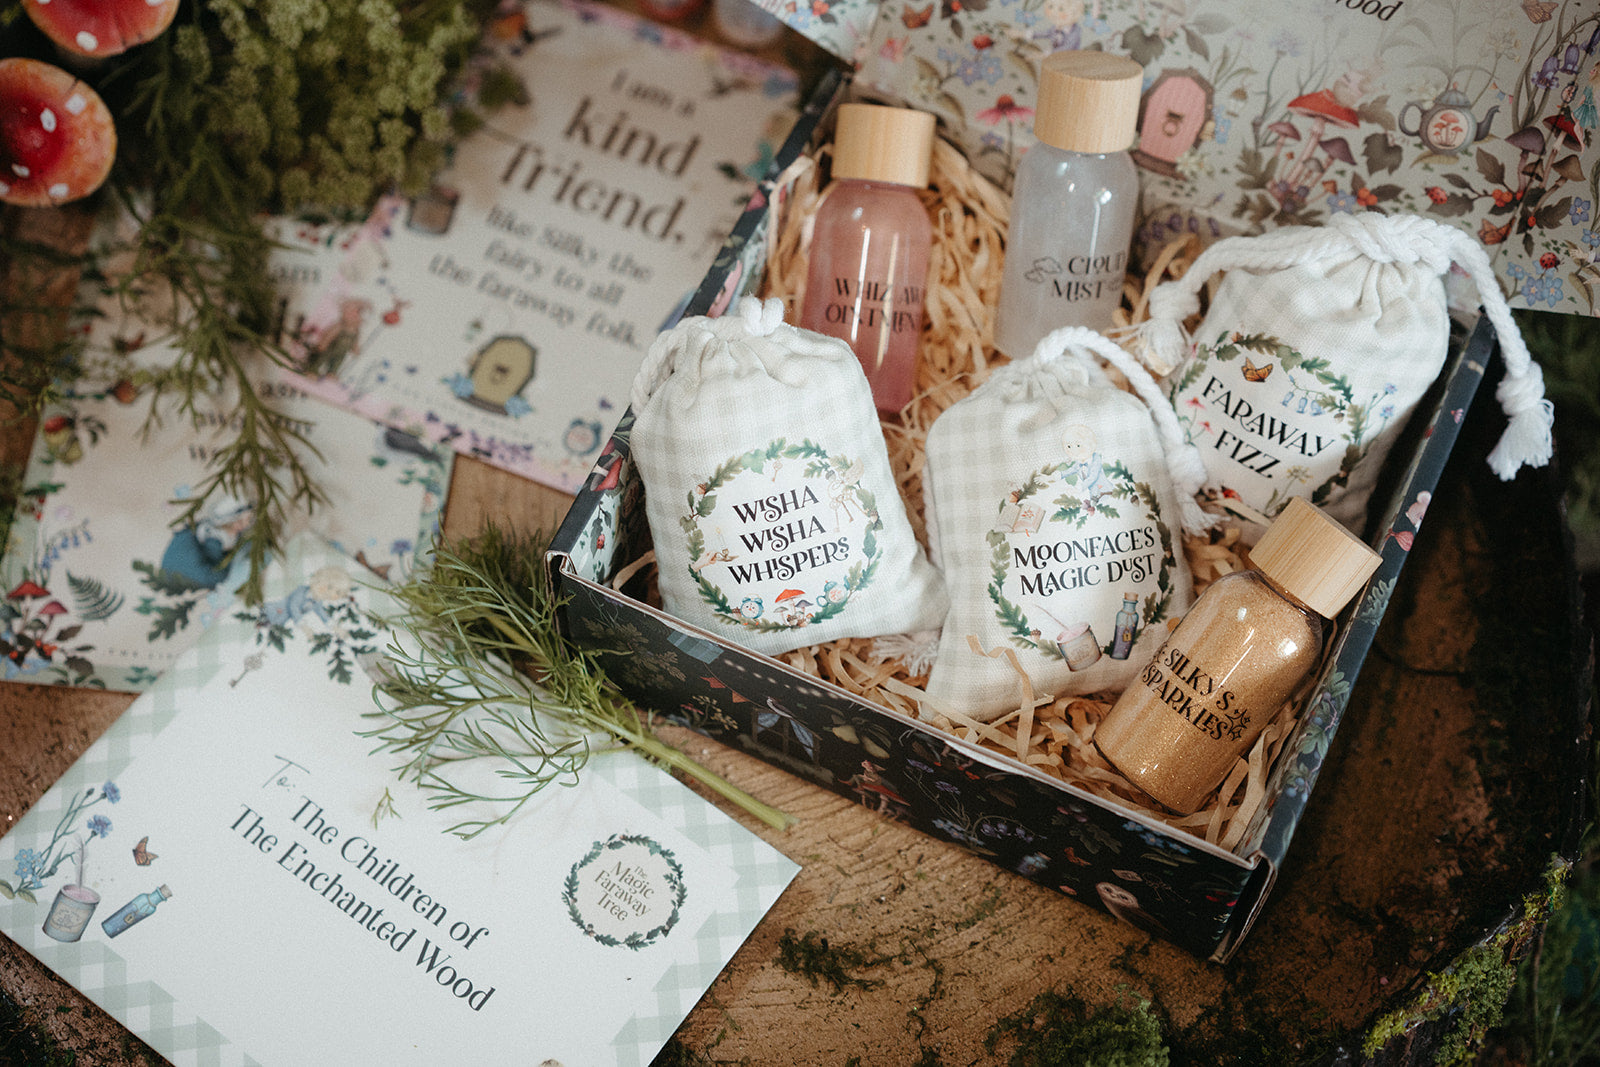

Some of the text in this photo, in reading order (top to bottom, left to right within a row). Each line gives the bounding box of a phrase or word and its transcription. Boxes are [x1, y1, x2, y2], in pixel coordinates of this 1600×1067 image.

[1336, 0, 1404, 21] ood
[565, 97, 702, 176] kind
[502, 143, 687, 242] friend.
[1051, 279, 1106, 302] MIST
[1202, 376, 1335, 457] FARAWAY
[1214, 430, 1281, 478] FIZZ
[732, 485, 820, 524] WISHA
[739, 516, 826, 553] WISHA
[1013, 526, 1155, 569] MOONFACE'S
[728, 537, 850, 584] WHISPERS
[1020, 553, 1155, 597] MAGIC DUST
[1142, 665, 1228, 740] SPARKLES
[290, 795, 490, 951] The Children of
[594, 869, 651, 917] Faraway
[610, 861, 655, 899] Magic
[230, 803, 496, 1012] The Enchanted Wood
[597, 890, 628, 921] Tree
